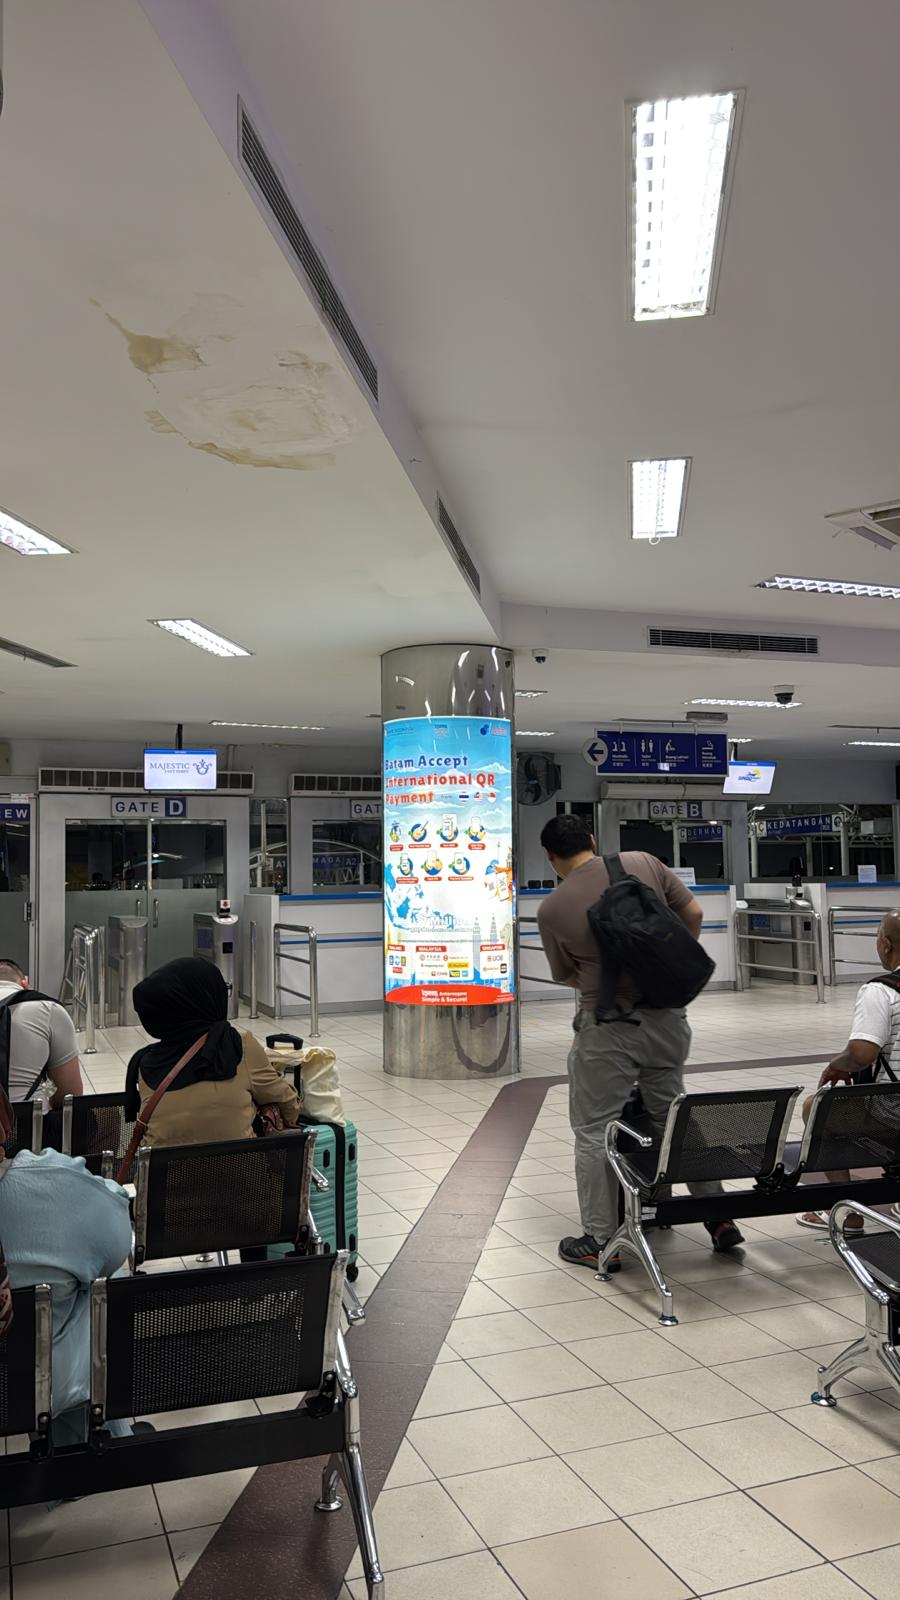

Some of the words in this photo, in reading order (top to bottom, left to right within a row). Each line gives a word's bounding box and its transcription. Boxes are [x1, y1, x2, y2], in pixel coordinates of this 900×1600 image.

[150, 762, 190, 770] MAJESTIC
[385, 758, 414, 770] Batam
[418, 755, 468, 768] Accept
[386, 772, 472, 788] International
[476, 773, 495, 787] QR
[386, 791, 434, 807] Payment
[0, 808, 28, 819] EW
[115, 801, 159, 813] GATE
[169, 800, 184, 815] D
[353, 803, 381, 814] GAT
[652, 805, 684, 815] GATE
[690, 803, 700, 817] B
[767, 817, 831, 830] KEDATANGAN
[687, 826, 722, 836] DERMAG
